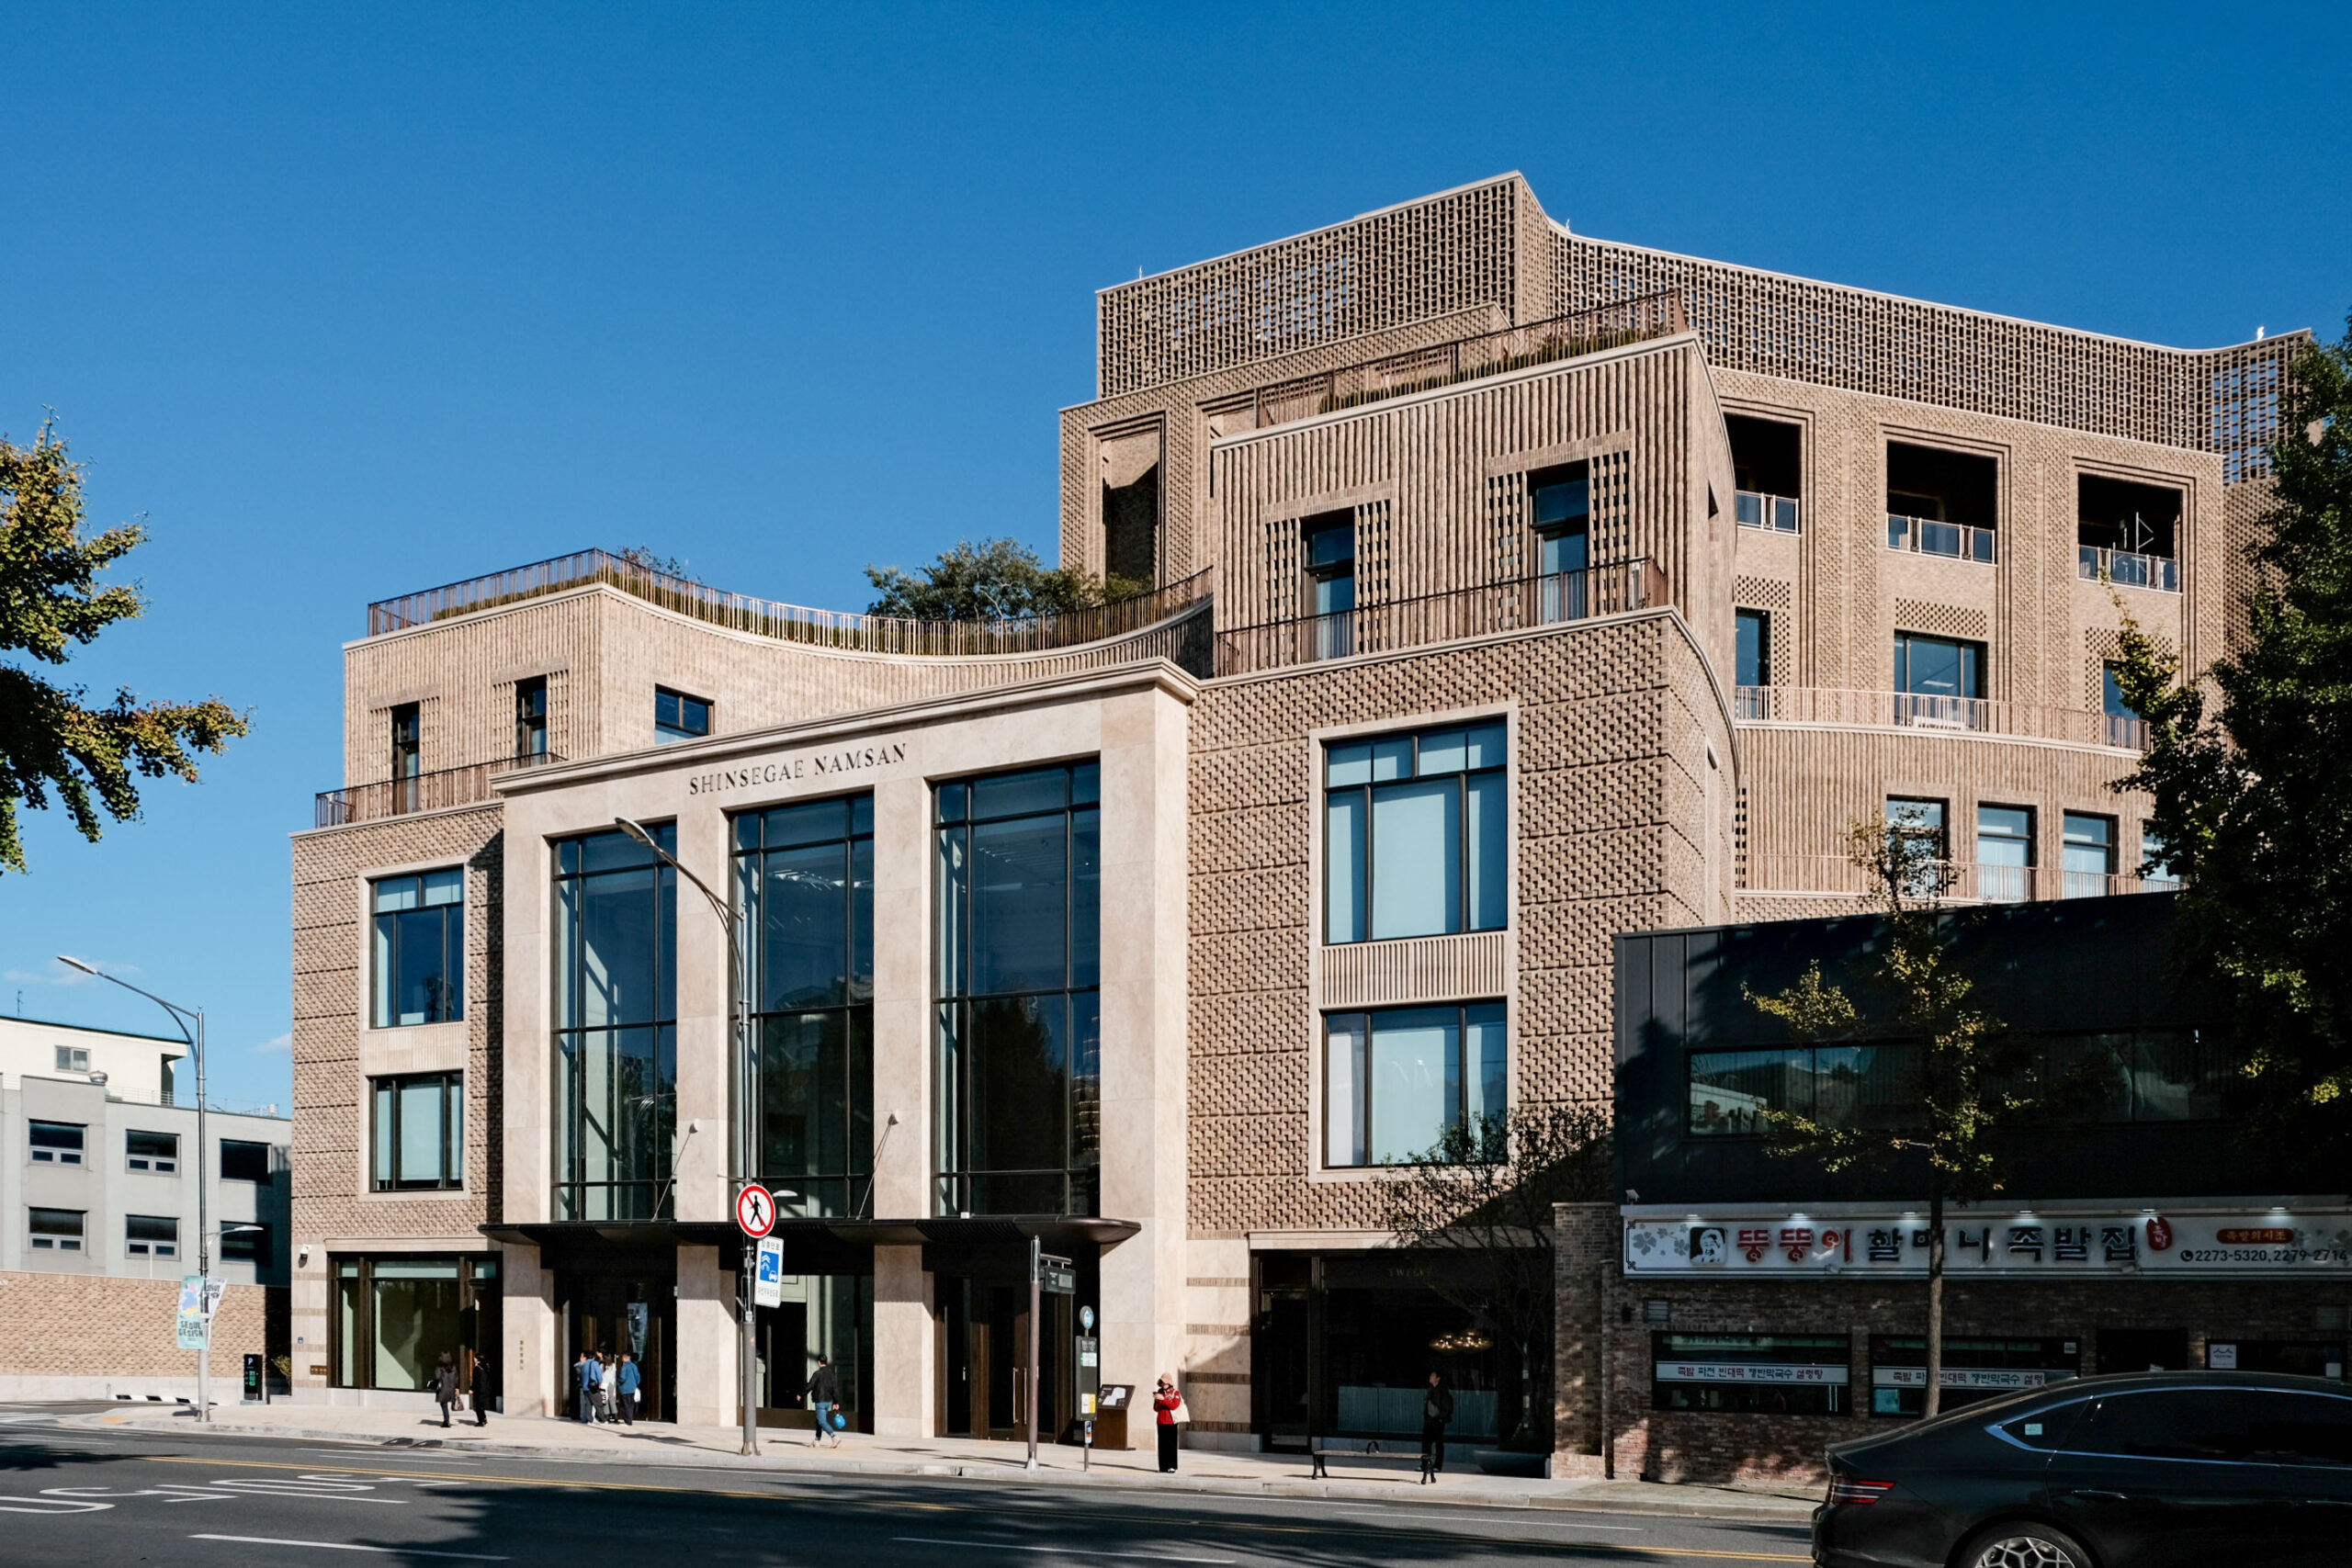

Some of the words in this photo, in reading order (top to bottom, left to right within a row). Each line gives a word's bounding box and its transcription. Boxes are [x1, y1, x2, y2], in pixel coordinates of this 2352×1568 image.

[689, 759, 805, 795] SHINSEGAE
[814, 742, 907, 776] NAMSAN
[1736, 1227, 1853, 1263] 뚱뚱이
[1867, 1226, 1991, 1263] 할머니
[2007, 1226, 2137, 1262] 족발집
[1677, 1366, 1695, 1377] 족발
[1698, 1367, 1716, 1378] 파전
[1718, 1367, 1745, 1378] 빈대떡
[1892, 1371, 1913, 1382] 족발
[2023, 1373, 2044, 1385] 설렁
